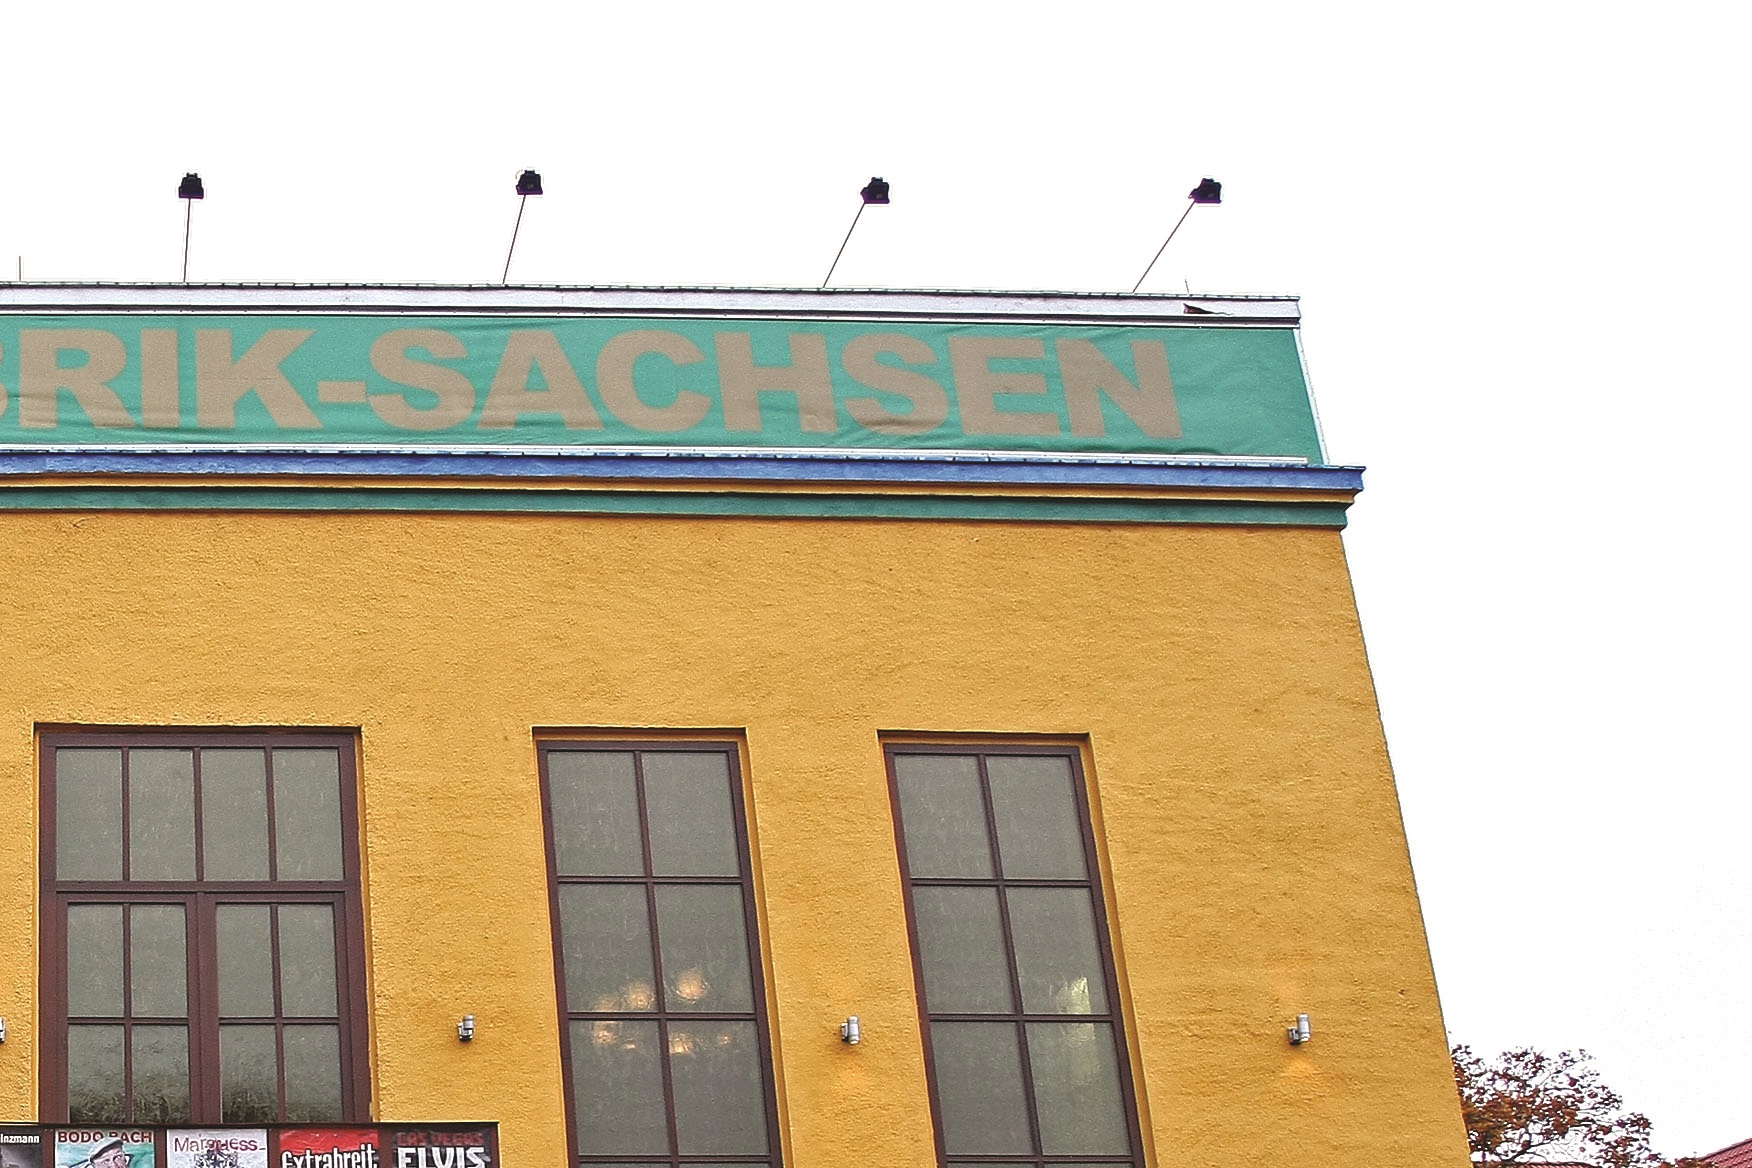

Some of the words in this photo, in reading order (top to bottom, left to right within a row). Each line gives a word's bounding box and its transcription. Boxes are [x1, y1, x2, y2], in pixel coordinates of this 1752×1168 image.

[58, 1131, 104, 1143] BODO
[397, 1132, 428, 1146] LAS
[431, 1132, 485, 1146] VEGAS
